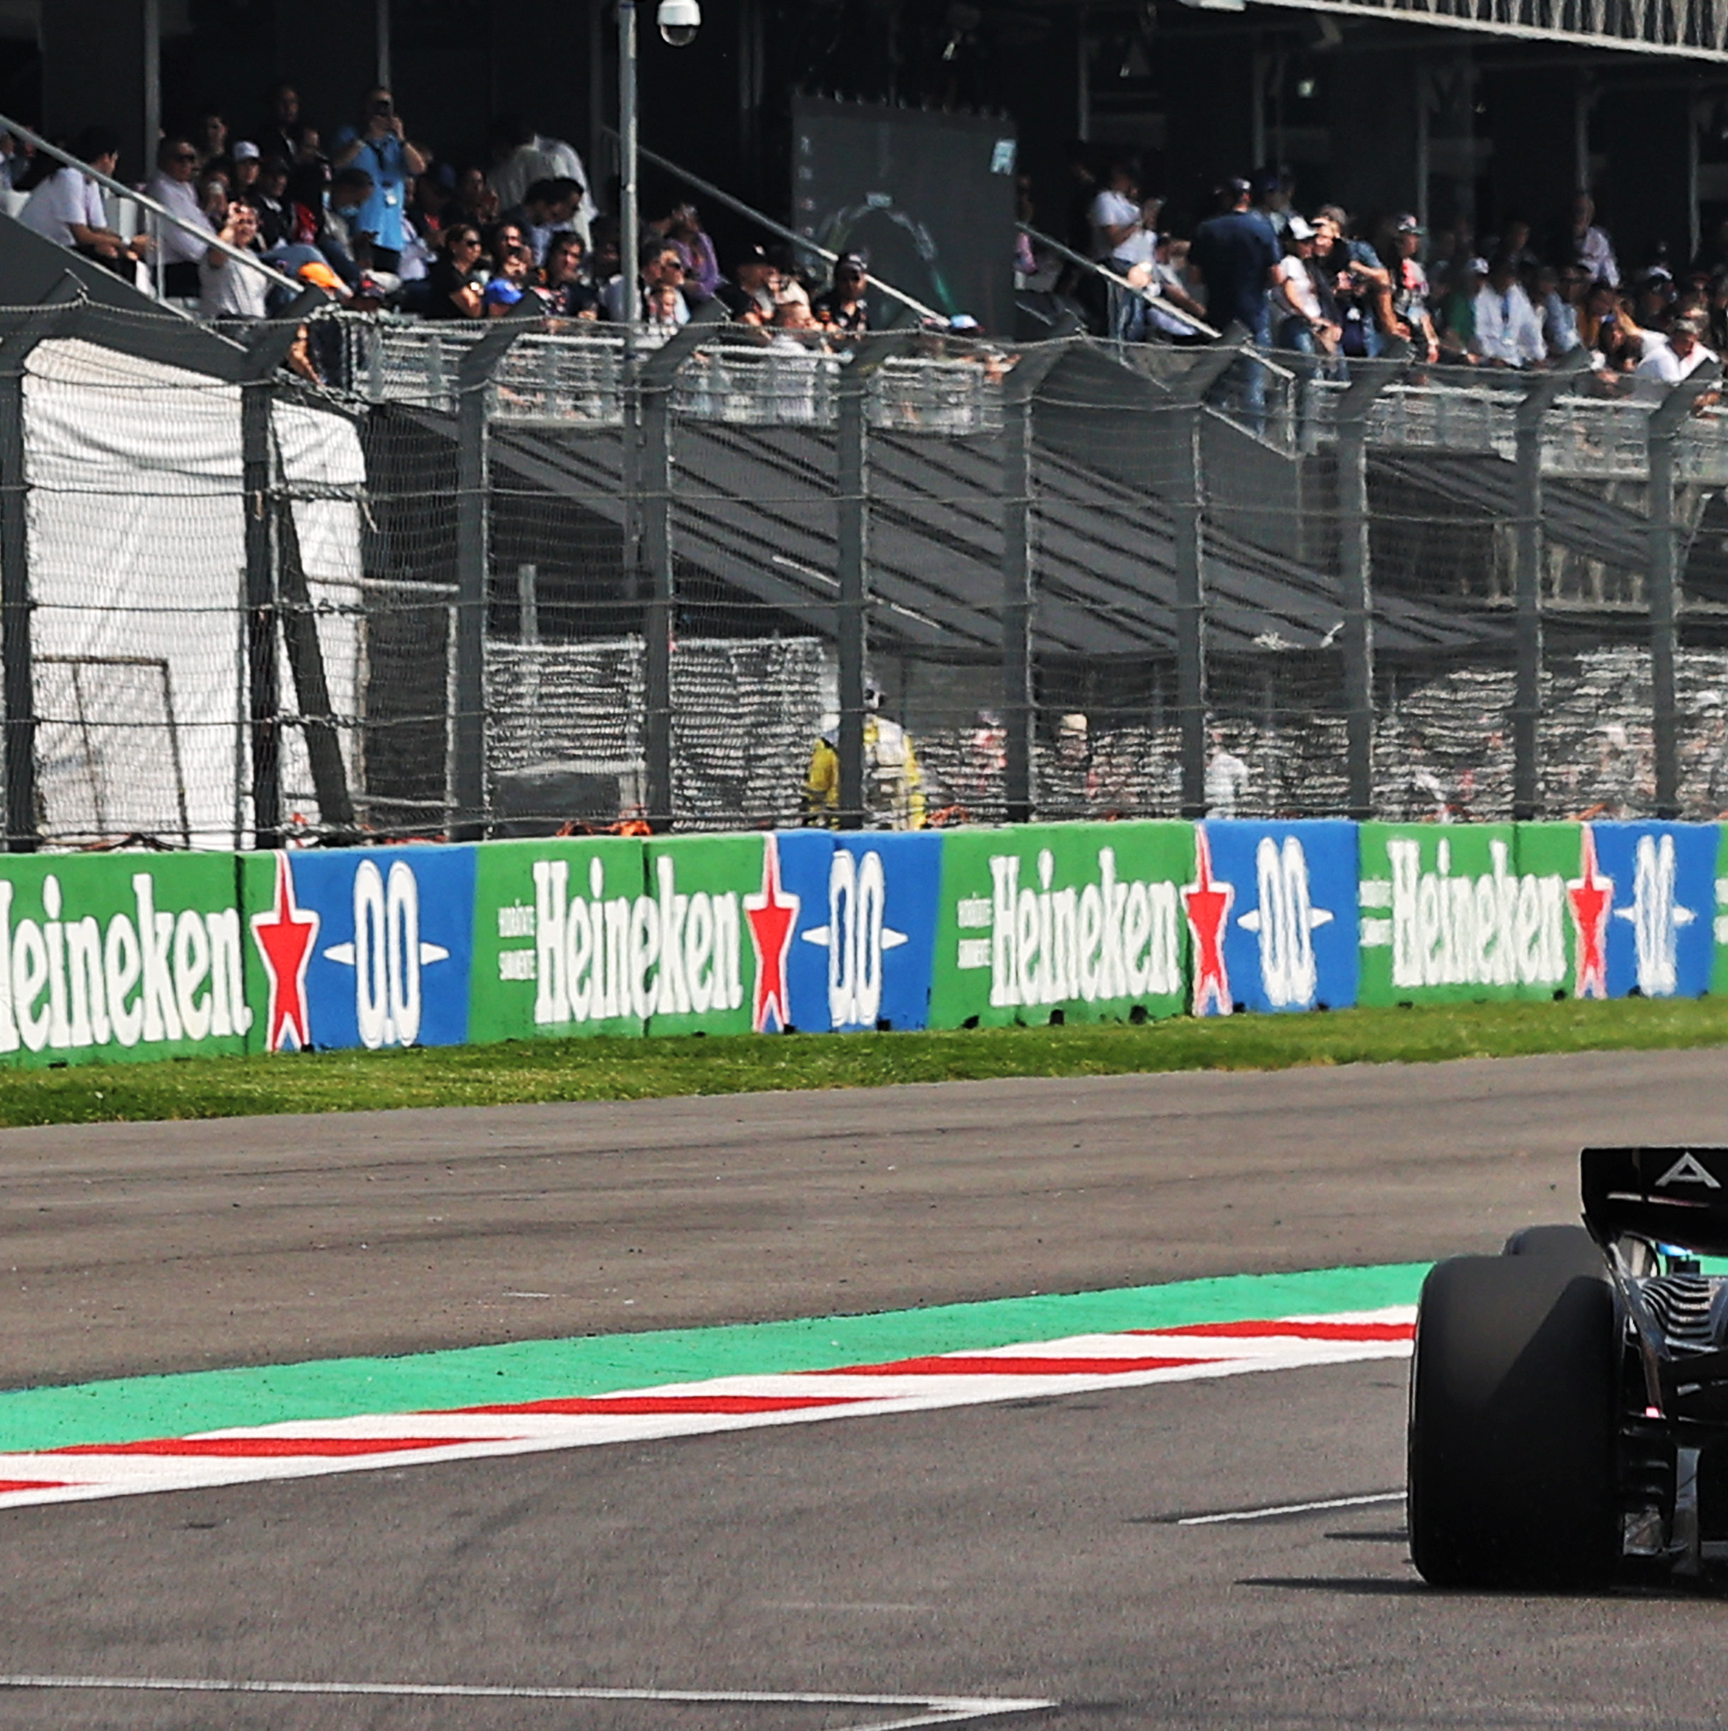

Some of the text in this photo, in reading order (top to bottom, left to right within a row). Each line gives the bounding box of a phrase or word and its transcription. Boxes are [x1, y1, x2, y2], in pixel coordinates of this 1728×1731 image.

[354, 859, 421, 1050] 0.0
[533, 855, 743, 1025] Heineken
[990, 846, 1184, 1008] Heineken
[1387, 837, 1568, 988] Heineken
